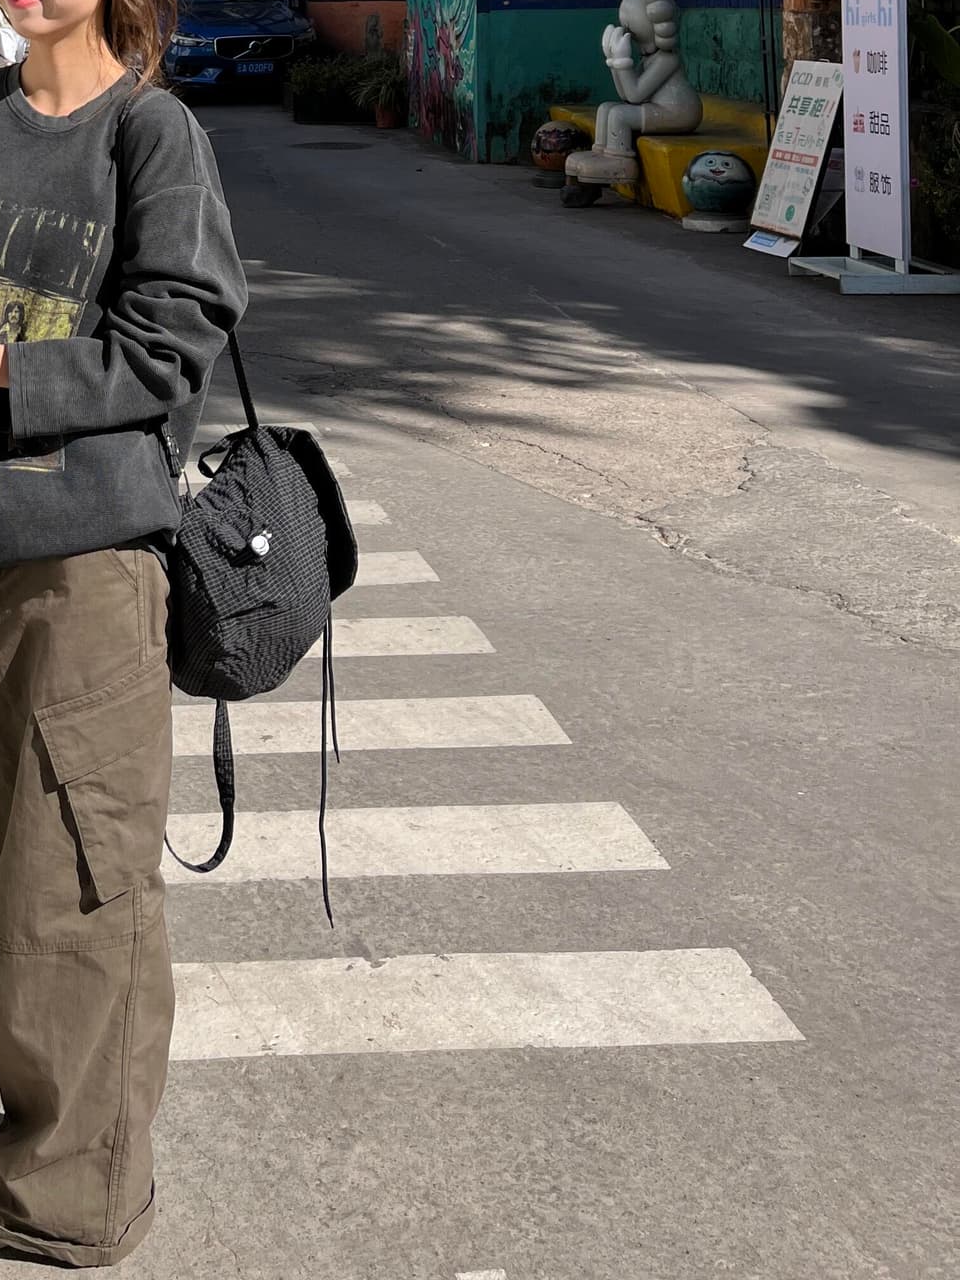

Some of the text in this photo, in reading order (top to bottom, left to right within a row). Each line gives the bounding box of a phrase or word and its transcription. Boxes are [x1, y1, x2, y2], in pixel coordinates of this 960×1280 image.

[867, 50, 888, 75] 咖啡
[791, 71, 813, 86] CCD
[869, 110, 891, 136] 甜品
[869, 170, 892, 196] 服饰
